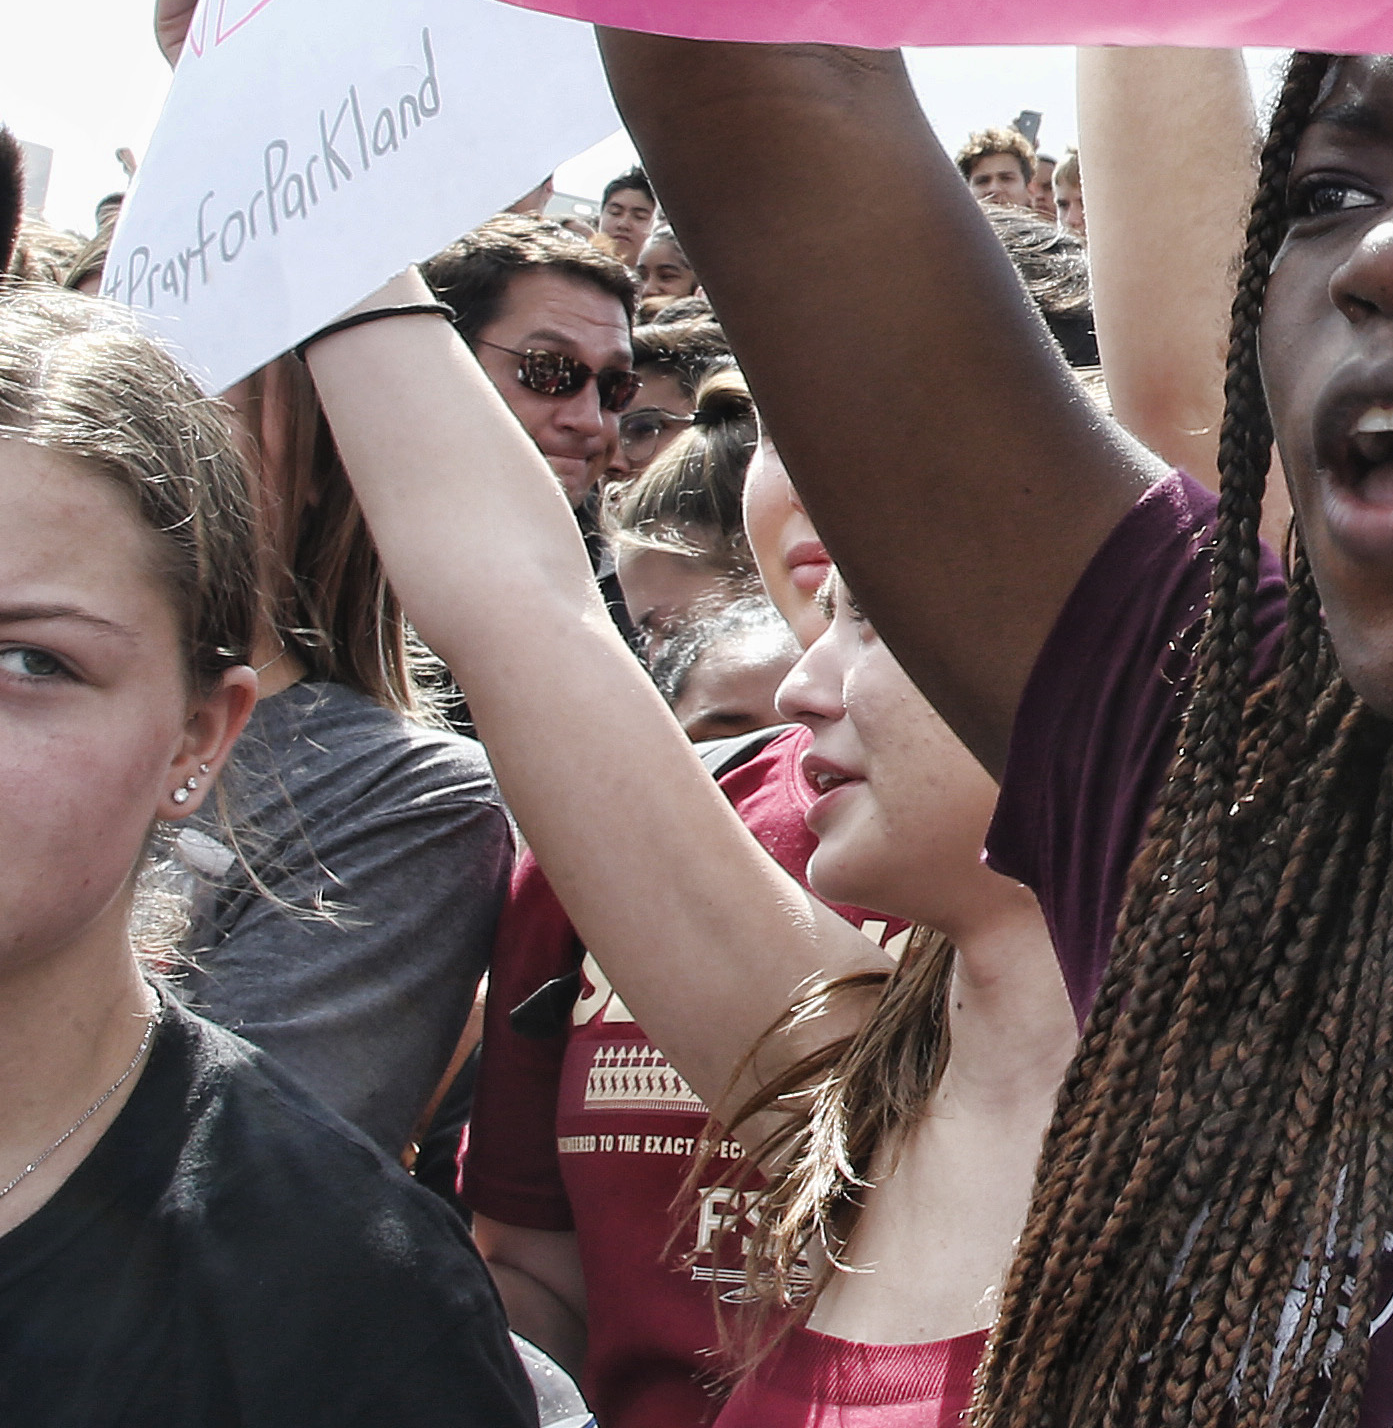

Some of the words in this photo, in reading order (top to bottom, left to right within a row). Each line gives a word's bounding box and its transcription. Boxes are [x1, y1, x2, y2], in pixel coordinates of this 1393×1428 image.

[599, 1134, 614, 1152] TO
[617, 1134, 640, 1153] THE
[644, 1135, 695, 1157] EXACT
